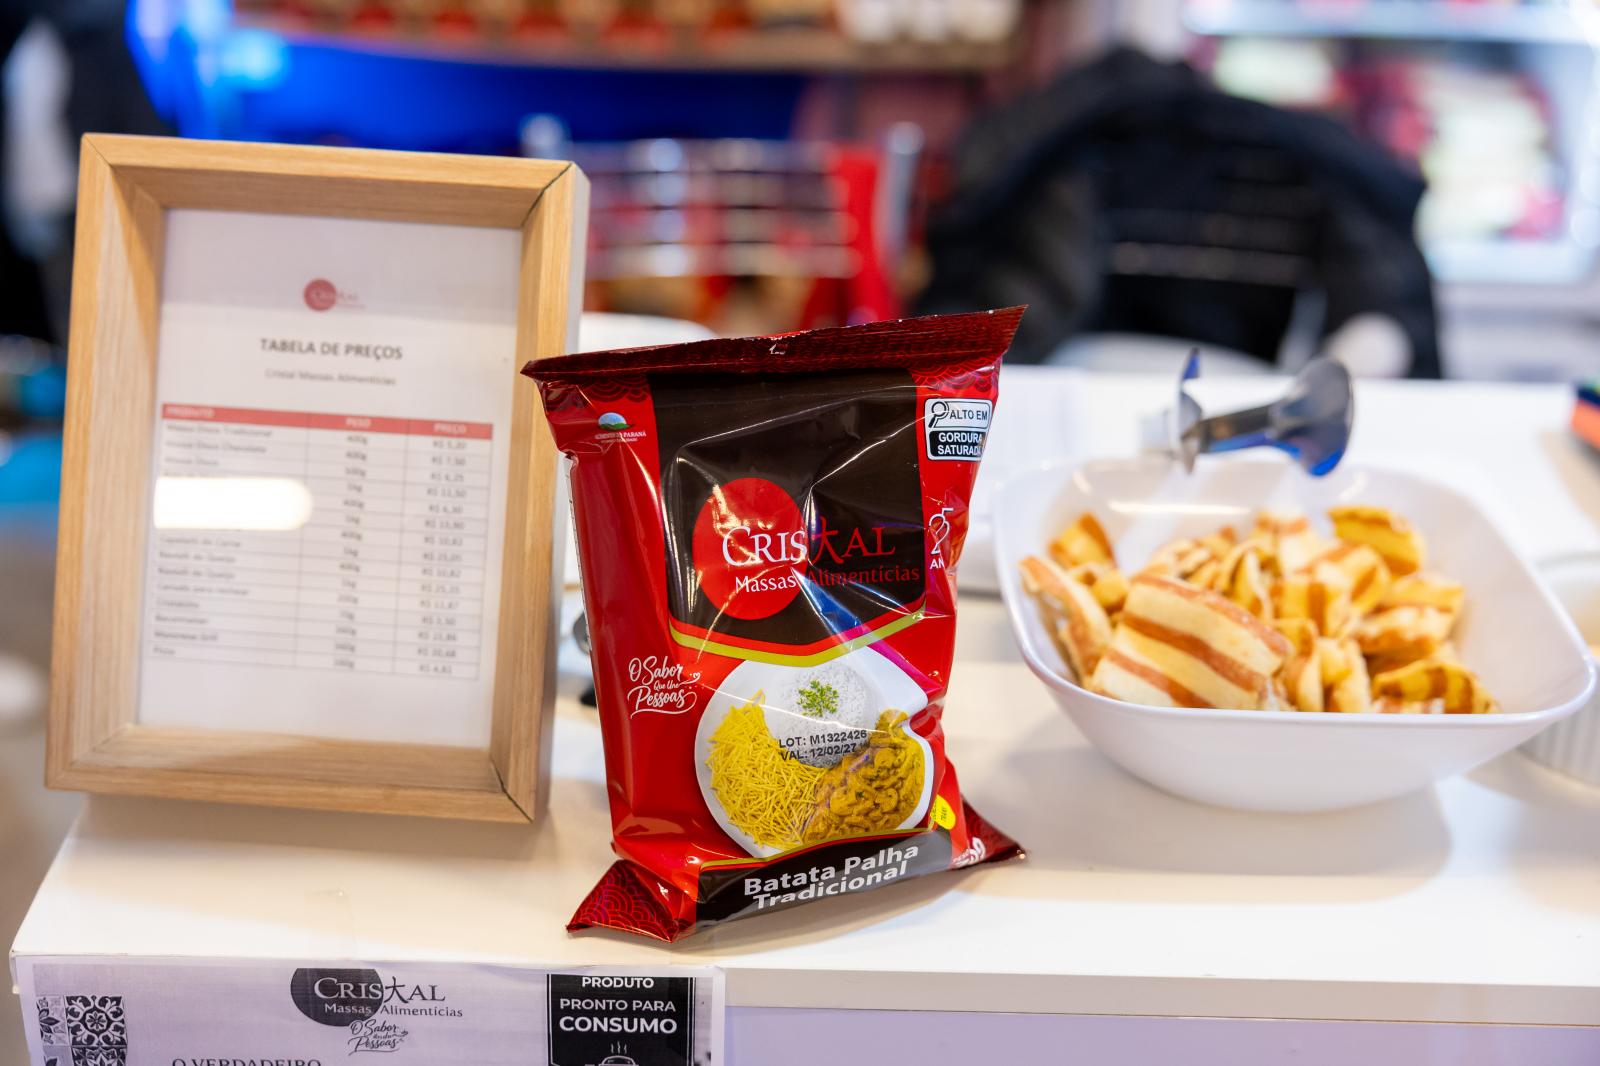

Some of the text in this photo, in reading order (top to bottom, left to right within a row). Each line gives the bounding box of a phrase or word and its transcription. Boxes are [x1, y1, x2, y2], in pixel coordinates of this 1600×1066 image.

[260, 338, 403, 360] TABELA DE PREÇOS
[950, 410, 987, 420] ALTO EM
[736, 565, 920, 593] Massas Alimentícias
[629, 656, 683, 685] O Sabor
[654, 680, 679, 691] Que Une
[628, 686, 691, 713] Pessoas
[779, 737, 806, 748] LOT:
[810, 730, 867, 745] M1322426
[780, 750, 808, 761] VAL:
[810, 743, 856, 757] 12/02/27
[744, 866, 835, 895] Batata
[844, 846, 918, 874] Palha
[753, 860, 907, 909] Tradicional
[582, 977, 654, 988] PRODUTO
[325, 1003, 463, 1017] Massas Alimentícias
[560, 999, 676, 1012] PRONTO PARA
[351, 1020, 362, 1035] O
[364, 1019, 398, 1037] Sabor
[559, 1016, 677, 1034] CONSUMO
[348, 1035, 399, 1052] Pessoas
